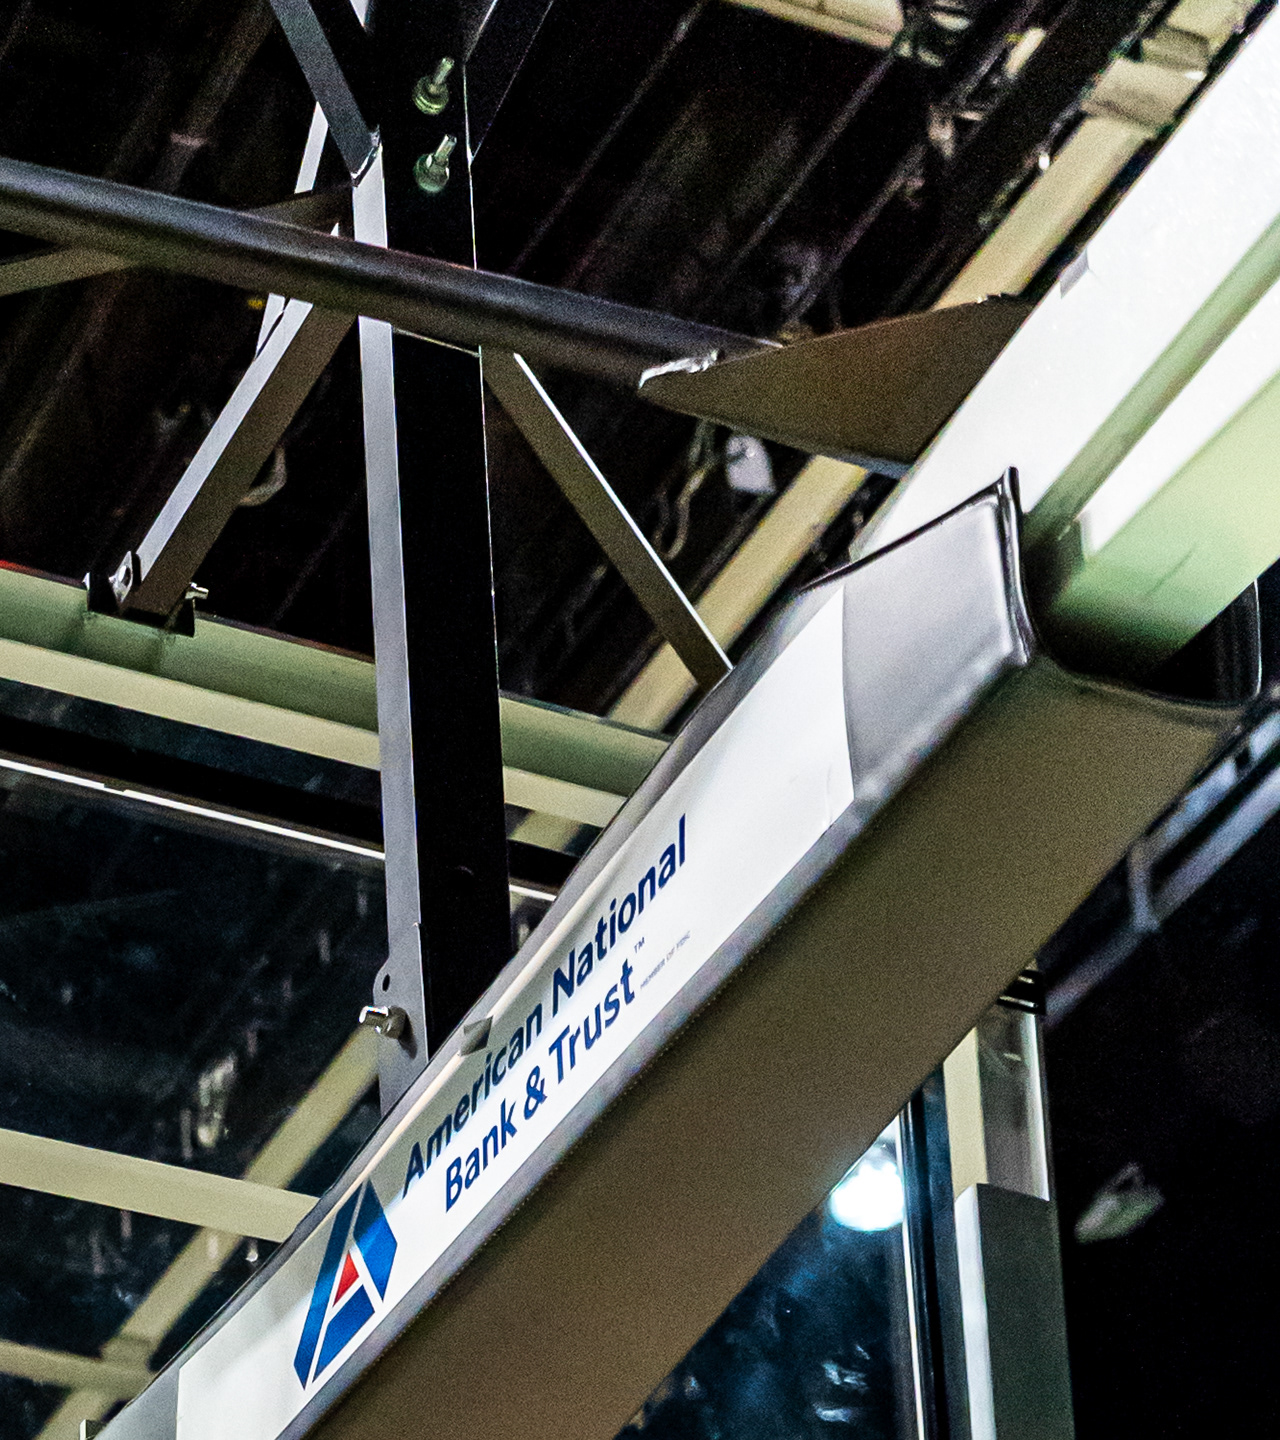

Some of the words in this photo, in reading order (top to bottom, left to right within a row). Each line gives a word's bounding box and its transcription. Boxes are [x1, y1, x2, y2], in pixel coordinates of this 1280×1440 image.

[401, 1003, 542, 1199] American
[550, 813, 687, 1019] National
[445, 1096, 518, 1213] Bank
[523, 1068, 547, 1122] &
[548, 959, 637, 1084] Trust
